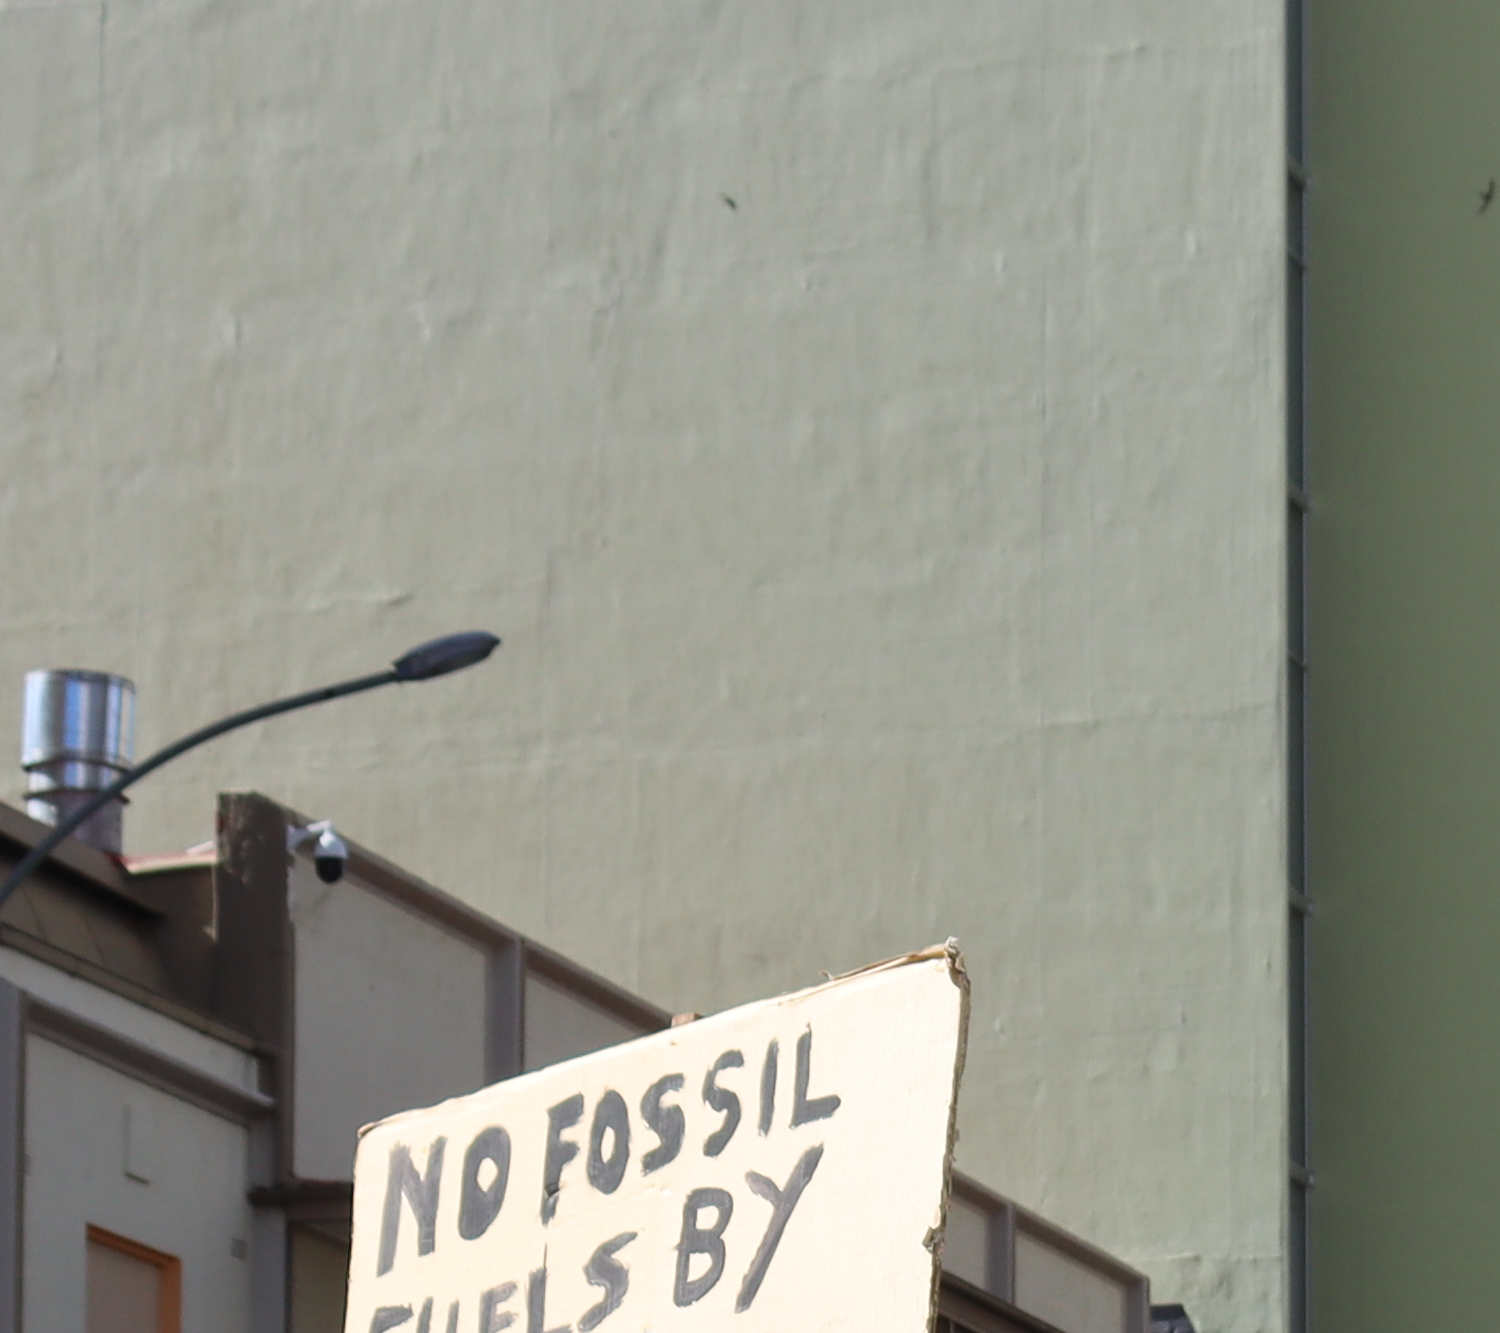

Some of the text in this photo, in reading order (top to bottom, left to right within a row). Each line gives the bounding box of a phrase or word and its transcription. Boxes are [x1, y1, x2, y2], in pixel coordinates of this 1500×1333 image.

[377, 1023, 841, 1277] NO FOSSIL
[673, 1143, 824, 1313] BY
